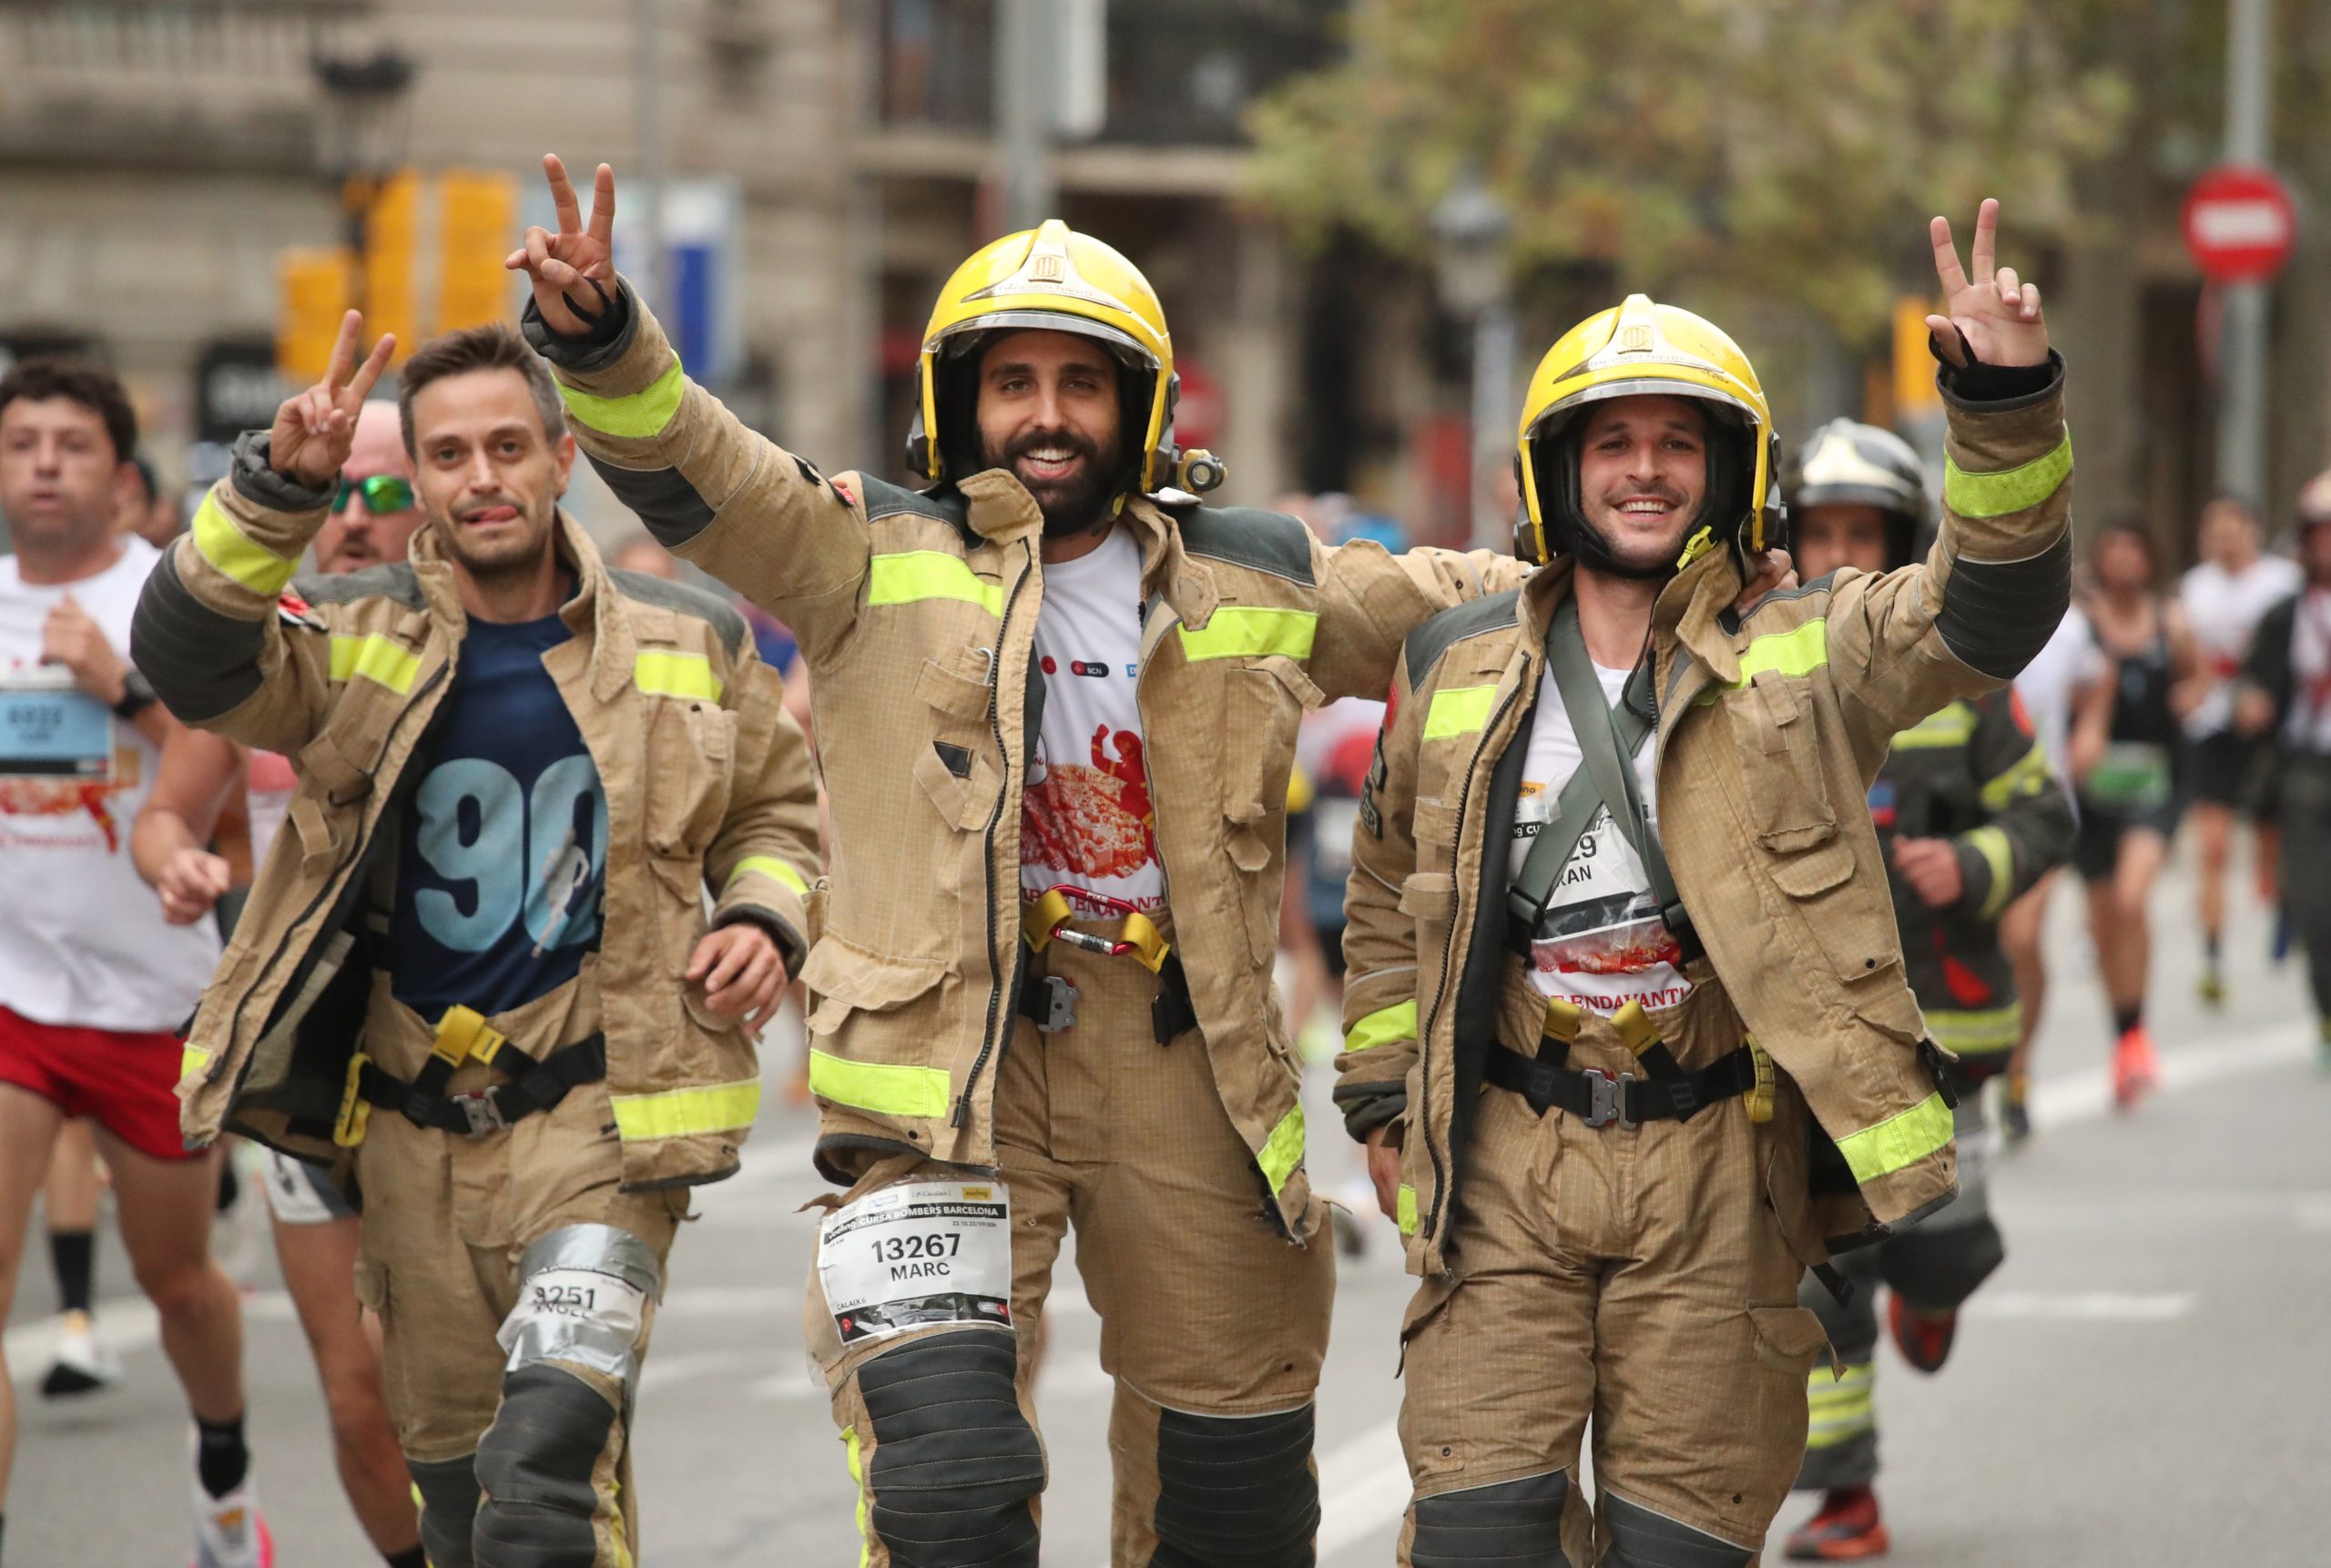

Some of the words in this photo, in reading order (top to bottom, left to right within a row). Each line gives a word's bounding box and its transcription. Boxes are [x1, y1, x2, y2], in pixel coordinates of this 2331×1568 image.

[414, 753, 609, 953] 90
[860, 1213, 891, 1226] CURSA
[893, 1206, 942, 1217] BOMBERS
[943, 1206, 998, 1216] BARCELONA
[870, 1233, 961, 1263] 13267
[891, 1261, 951, 1282] MARC
[837, 1299, 860, 1310] CALAIX
